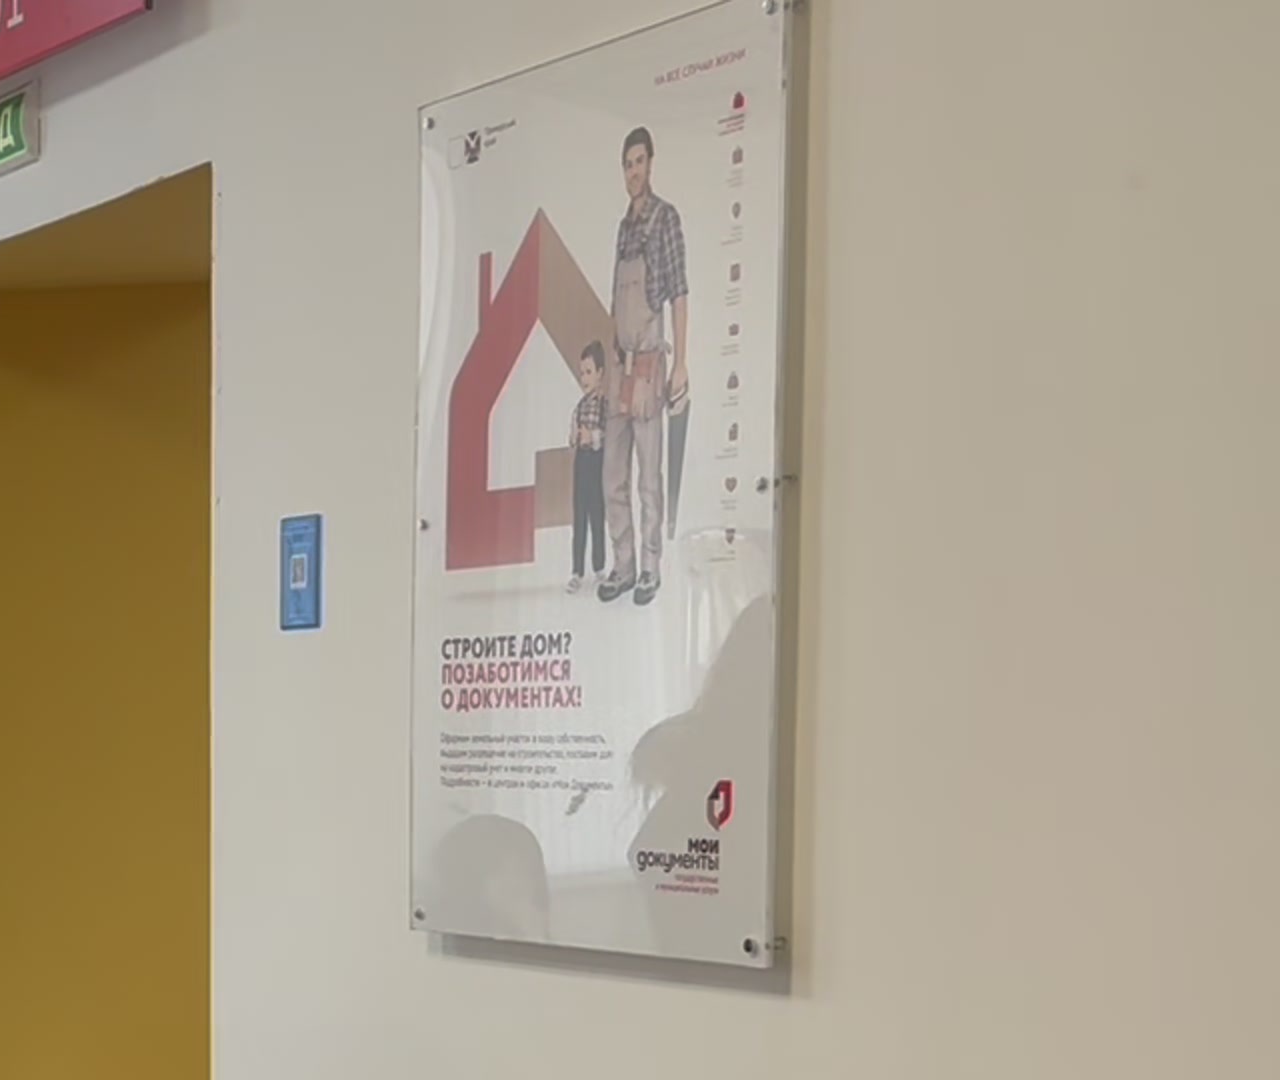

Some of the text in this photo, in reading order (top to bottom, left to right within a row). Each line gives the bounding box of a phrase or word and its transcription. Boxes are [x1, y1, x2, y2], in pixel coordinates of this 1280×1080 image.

[441, 632, 572, 660] СТРОИТЕ ДОМ?
[441, 659, 571, 685] ПОЗАБОТИМСЯ
[441, 685, 582, 712] О ДОКУМЕНТАХ!
